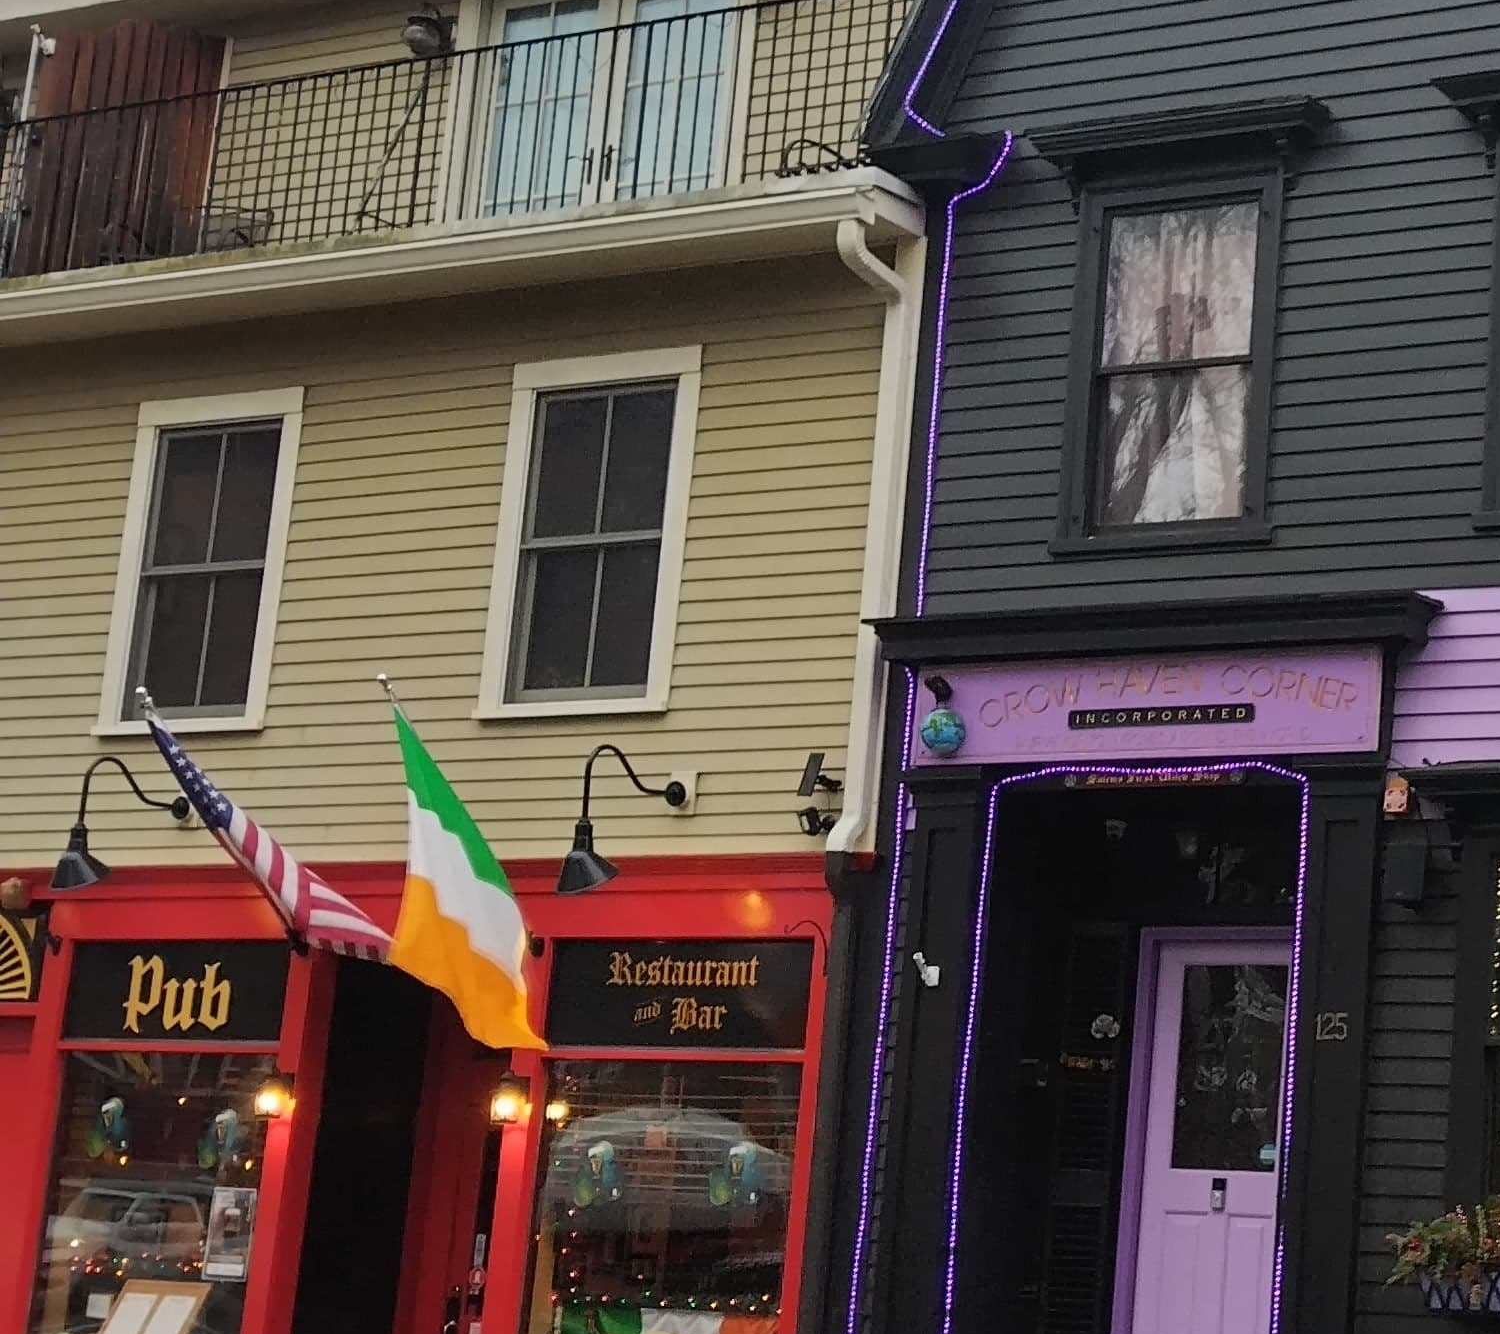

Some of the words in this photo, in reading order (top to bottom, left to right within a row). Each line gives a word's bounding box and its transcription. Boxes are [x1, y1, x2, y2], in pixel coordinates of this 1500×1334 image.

[979, 673, 1084, 728] CROW
[1096, 665, 1203, 699] HAVEN
[1221, 666, 1360, 713] CORNER
[1075, 707, 1248, 725] INCORPORATED
[605, 951, 760, 987] Restaurant
[122, 954, 231, 1034] Pub
[632, 1001, 662, 1023] and
[670, 996, 728, 1035] Bar
[1315, 1012, 1348, 1041] 125
